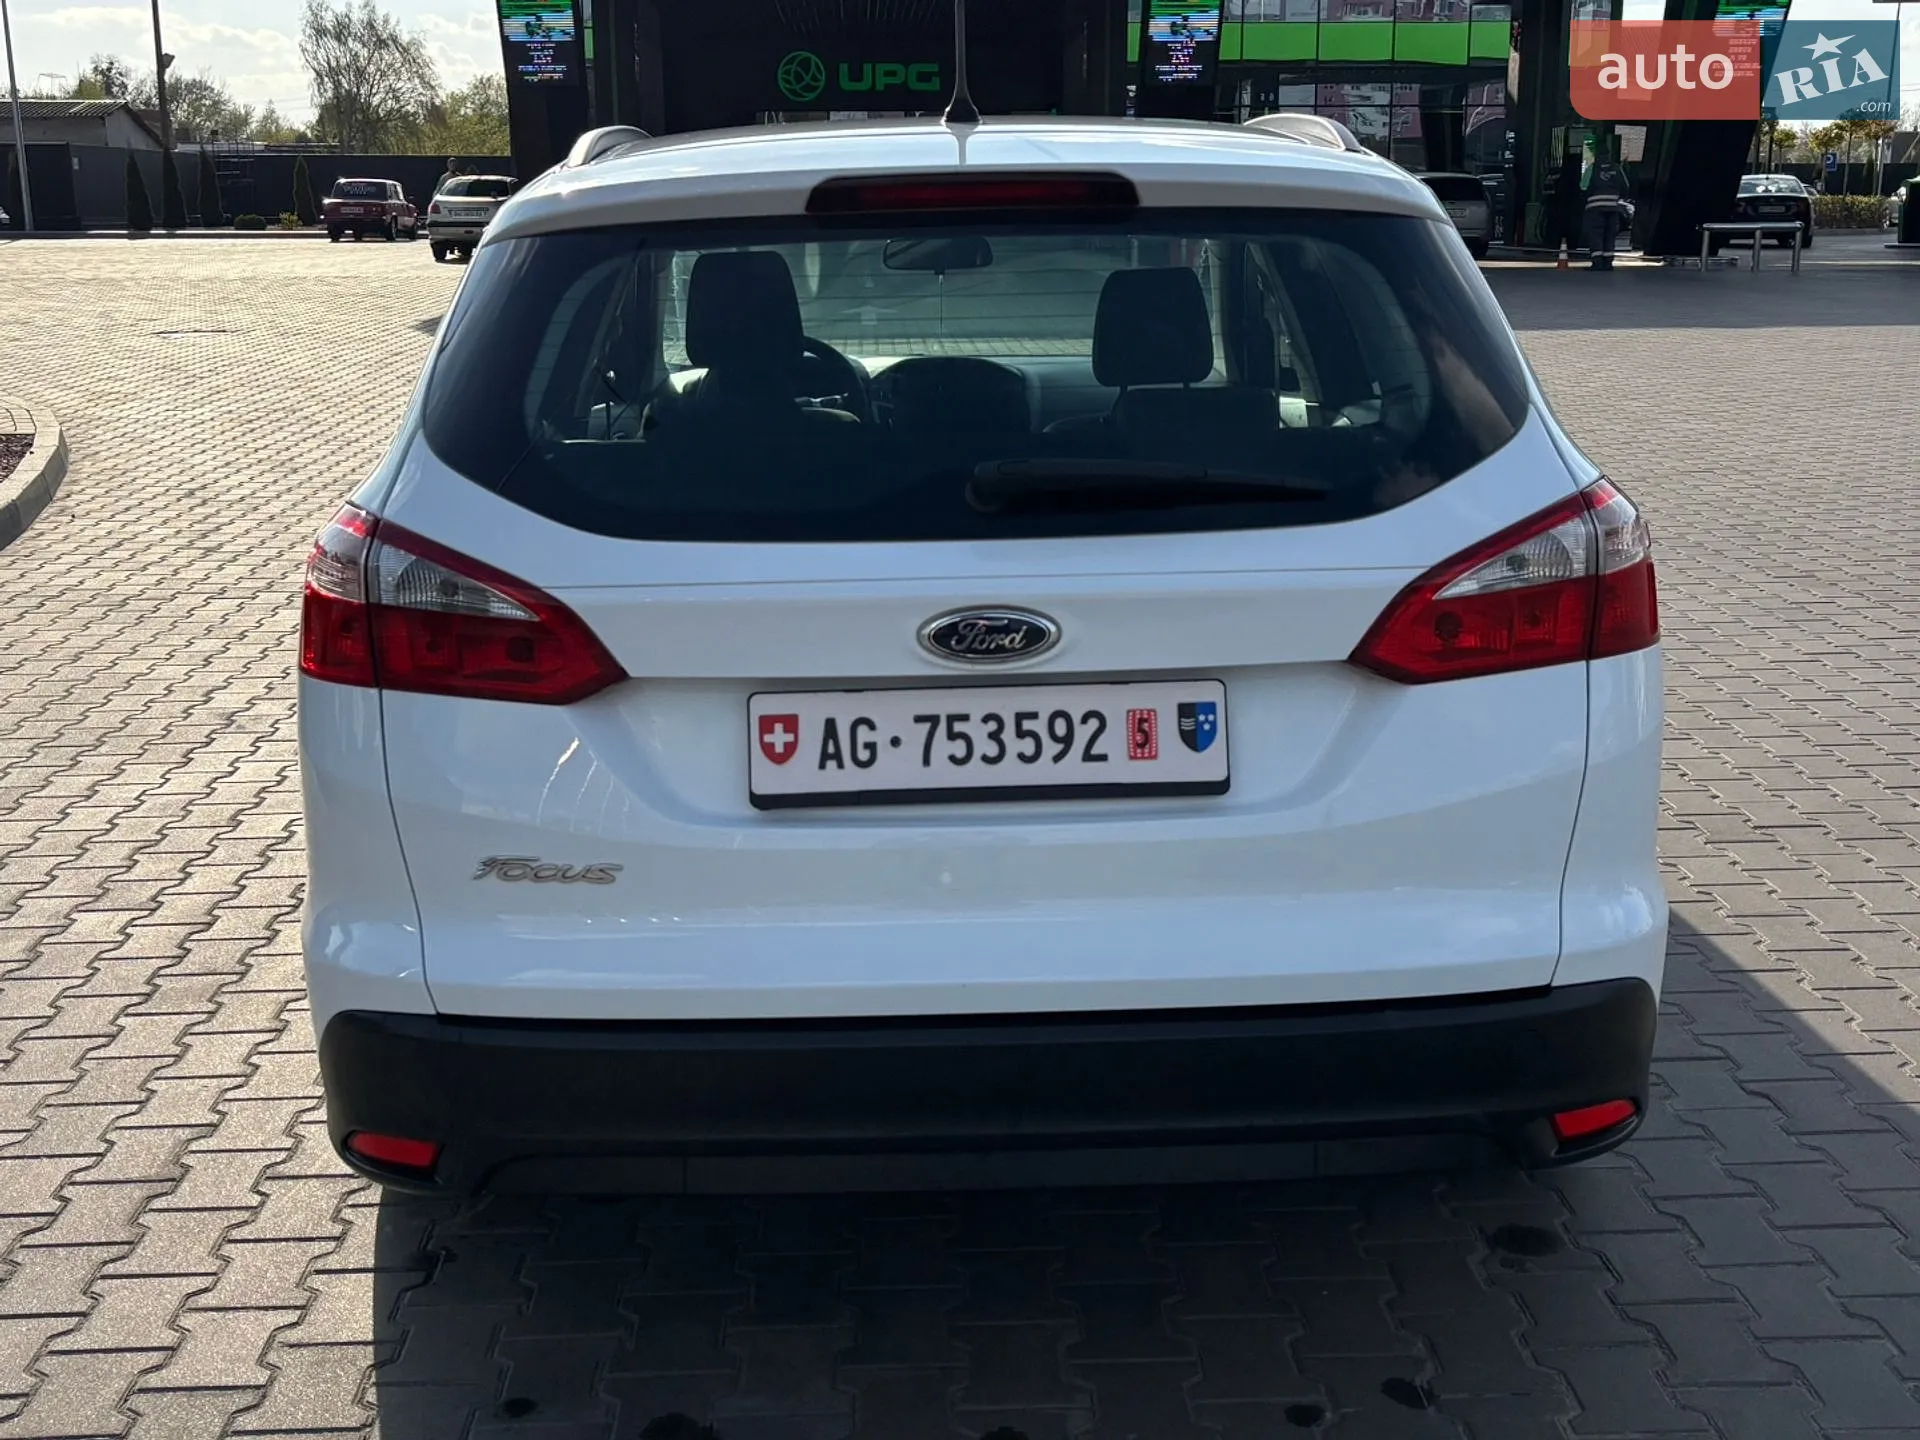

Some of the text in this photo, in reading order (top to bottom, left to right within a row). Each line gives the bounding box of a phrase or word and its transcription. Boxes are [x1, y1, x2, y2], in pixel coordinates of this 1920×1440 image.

[838, 62, 941, 91] UPG
[950, 618, 1029, 651] Ford
[1135, 717, 1150, 750] 5
